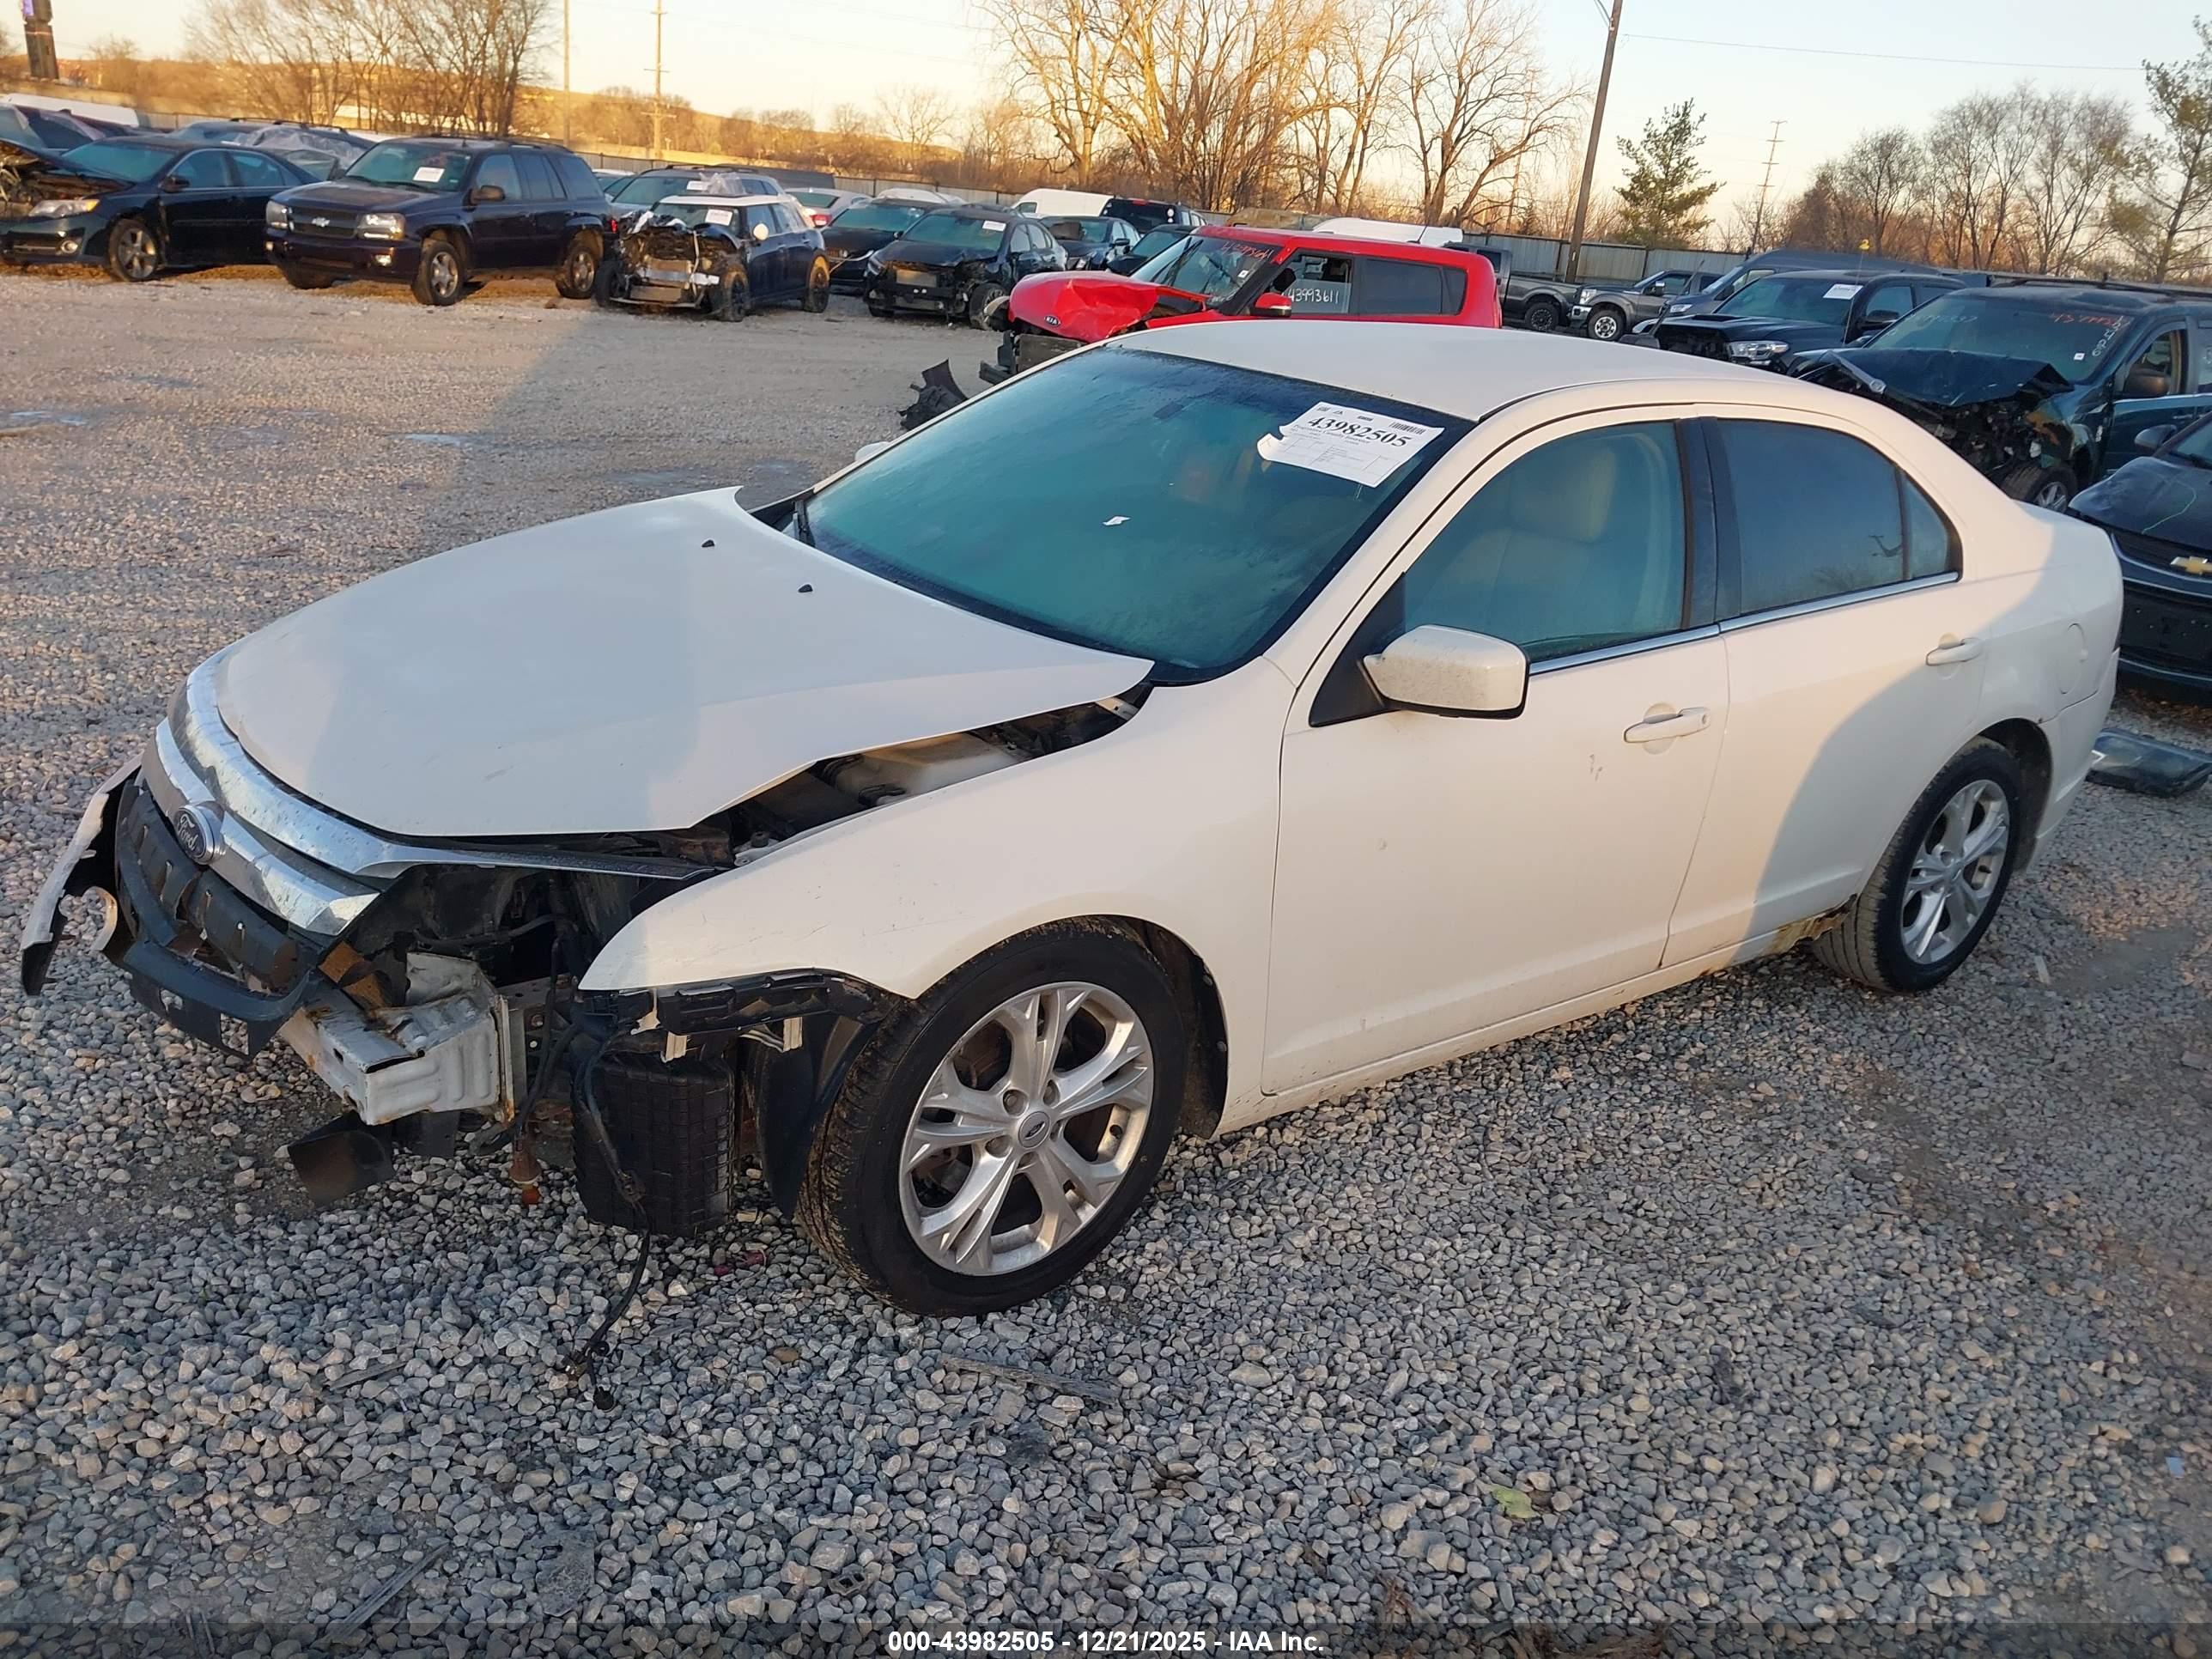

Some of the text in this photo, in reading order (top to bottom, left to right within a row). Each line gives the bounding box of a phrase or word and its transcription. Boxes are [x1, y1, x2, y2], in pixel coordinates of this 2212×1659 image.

[1288, 287, 1340, 304] 43993611
[1046, 316, 1058, 325] KIA
[1307, 416, 1413, 447] 43982505
[177, 813, 199, 851] Ford
